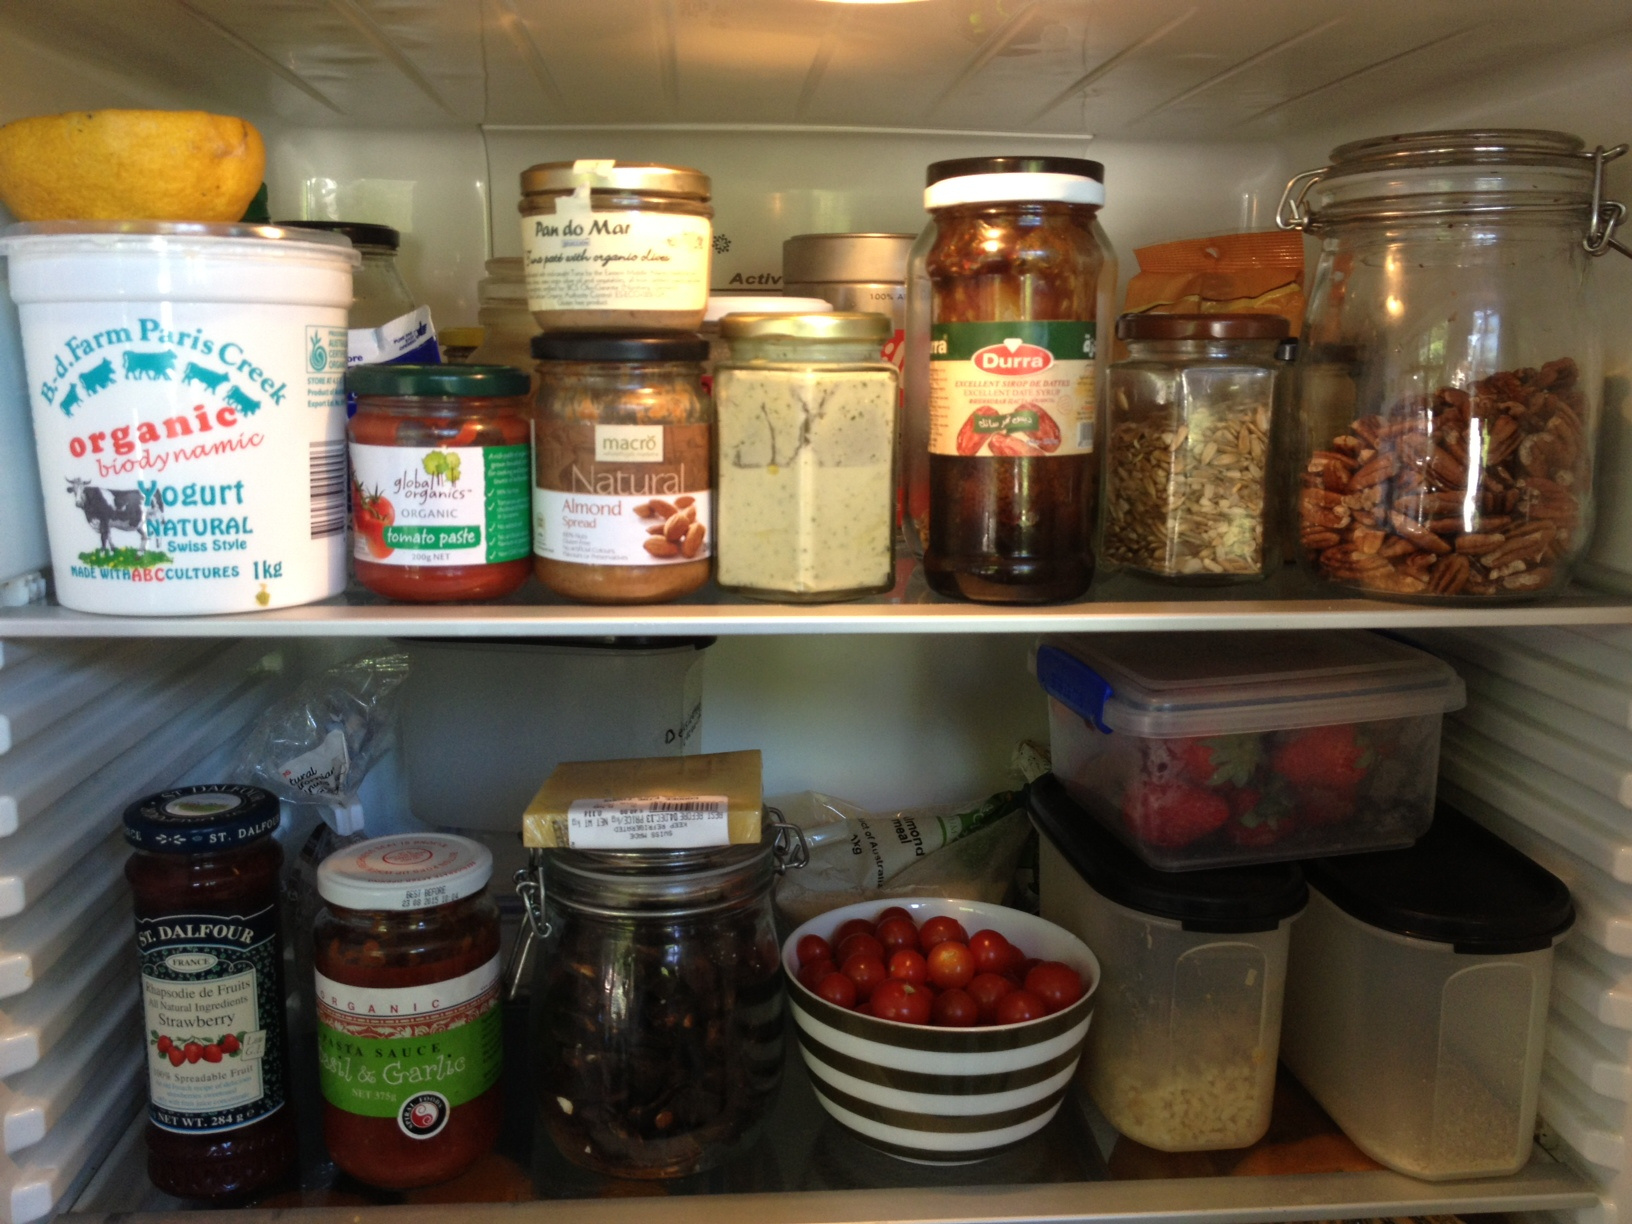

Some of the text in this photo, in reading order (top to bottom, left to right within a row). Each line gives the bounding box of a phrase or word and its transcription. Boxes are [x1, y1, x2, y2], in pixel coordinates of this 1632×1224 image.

[535, 219, 631, 237] Pan do Mar
[565, 249, 590, 262] with
[593, 253, 637, 267] organic
[137, 318, 214, 356] Paris
[218, 342, 288, 406] Creek
[982, 353, 1044, 369] Durra
[964, 389, 1010, 397] EXCELLENT
[69, 404, 239, 458] organic
[95, 432, 264, 478] biodynamic
[394, 468, 435, 494] global
[571, 462, 685, 496] Natural
[138, 480, 245, 507] Yogurt
[405, 489, 465, 505] organics
[401, 508, 458, 518] ORGANIC
[562, 499, 622, 517] Almond
[145, 516, 254, 538] NATURAL
[562, 516, 597, 530] Spread
[167, 538, 248, 553] Swiss Style
[387, 528, 435, 544] tomato
[439, 527, 476, 548] paste
[411, 553, 432, 561] 200g
[71, 564, 97, 580] MADE
[165, 565, 240, 580] CULTURES
[596, 818, 608, 827] NET
[679, 813, 704, 822] BEFORE
[614, 823, 666, 832] REFRIGERATED
[650, 830, 673, 838] SWISS
[890, 818, 912, 845] meal
[902, 815, 925, 857] lmond
[208, 833, 232, 844] ST.
[857, 818, 885, 889] uct of Australia
[406, 885, 446, 899] BEST BEFORE
[423, 895, 439, 906] 2015
[138, 924, 255, 947] ST. DALFOUR
[172, 957, 211, 967] FRANCE
[146, 979, 251, 1002] Rhapsodie de Fruits
[148, 995, 249, 1015] All Natural Ingredients
[320, 990, 440, 1014] ORGANIC
[158, 1011, 236, 1029] Strawberry
[322, 1032, 441, 1058] PASTA SAUCE
[175, 1071, 228, 1085] Spreadable
[230, 1064, 254, 1078] Fruit
[319, 1047, 466, 1086] asil & Garlic
[351, 1087, 397, 1102] NET 375g
[158, 1111, 243, 1127] NET WT. 284 g
